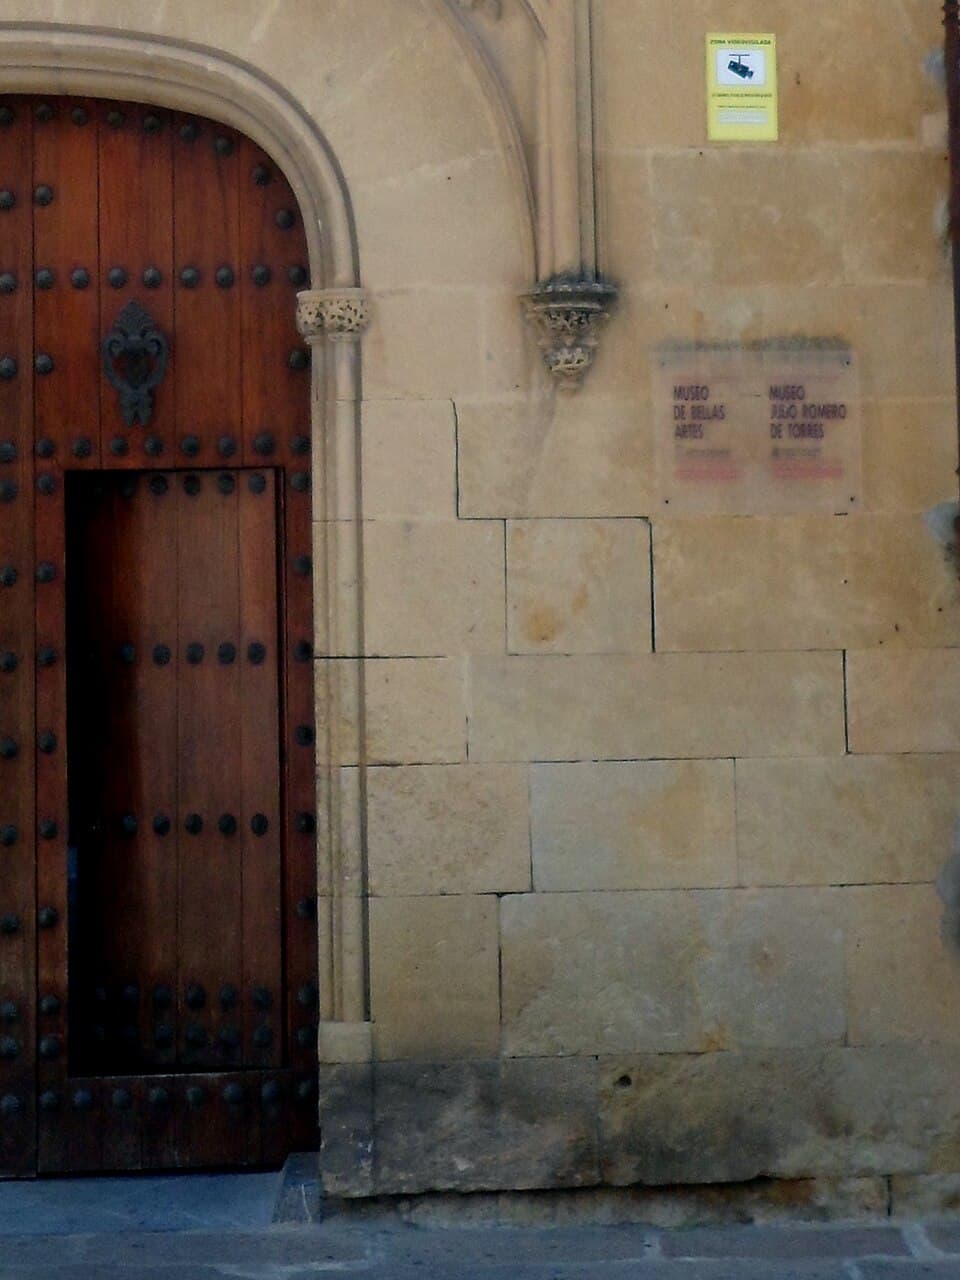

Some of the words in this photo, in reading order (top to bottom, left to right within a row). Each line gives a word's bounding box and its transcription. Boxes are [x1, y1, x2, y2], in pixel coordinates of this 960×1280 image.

[673, 385, 710, 401] MUSEO
[769, 385, 806, 401] MUSEO
[673, 405, 687, 421] DE
[691, 405, 726, 421] BELLAS
[771, 405, 798, 420] JULIO
[802, 404, 847, 420] ROMERO
[674, 424, 704, 439] ARTES
[771, 424, 783, 439] DE
[788, 423, 825, 439] TORRES
